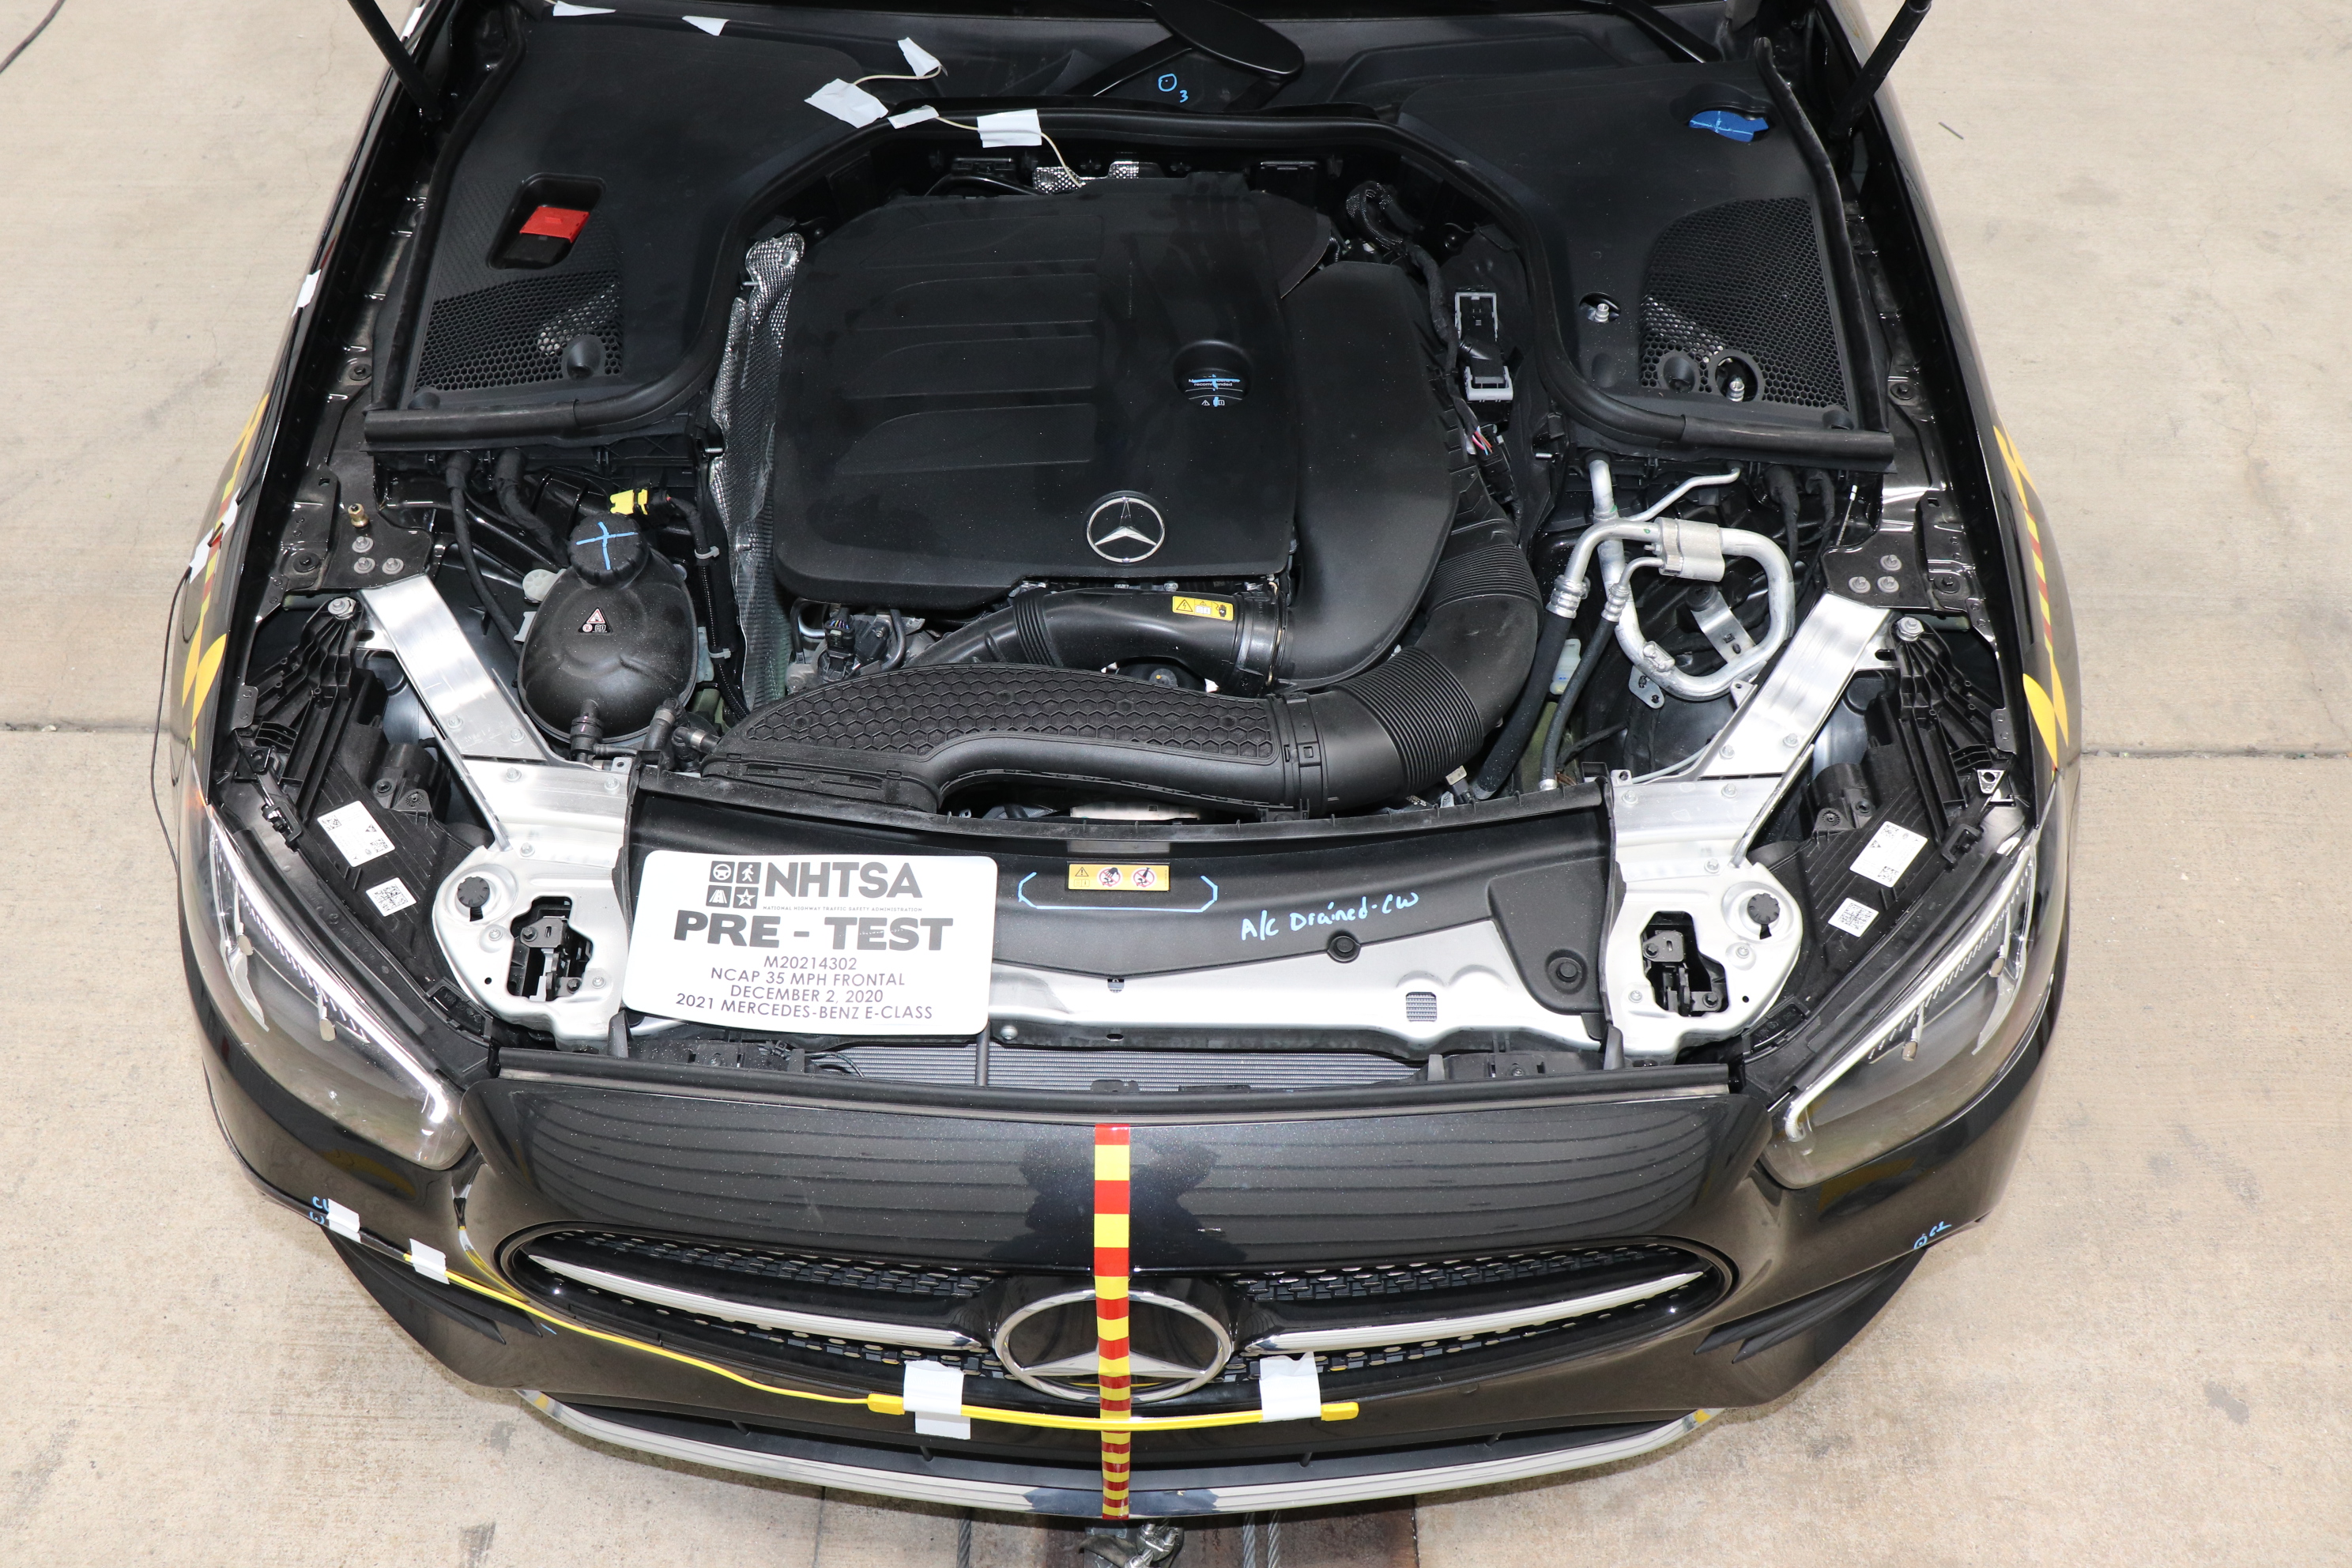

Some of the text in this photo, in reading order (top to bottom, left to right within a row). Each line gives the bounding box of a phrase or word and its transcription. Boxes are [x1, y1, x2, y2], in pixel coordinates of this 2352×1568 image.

[765, 862, 922, 898] NHTSA
[674, 910, 781, 948] PRE
[824, 917, 953, 951] TEST
[764, 956, 856, 970] M20214302
[711, 967, 904, 986] NCAP 35 MPH FRONTAL
[731, 985, 883, 1004] DECEMBER 2, 2020
[676, 993, 932, 1019] 2021 MERCEDES-BENZ E-CLASS
